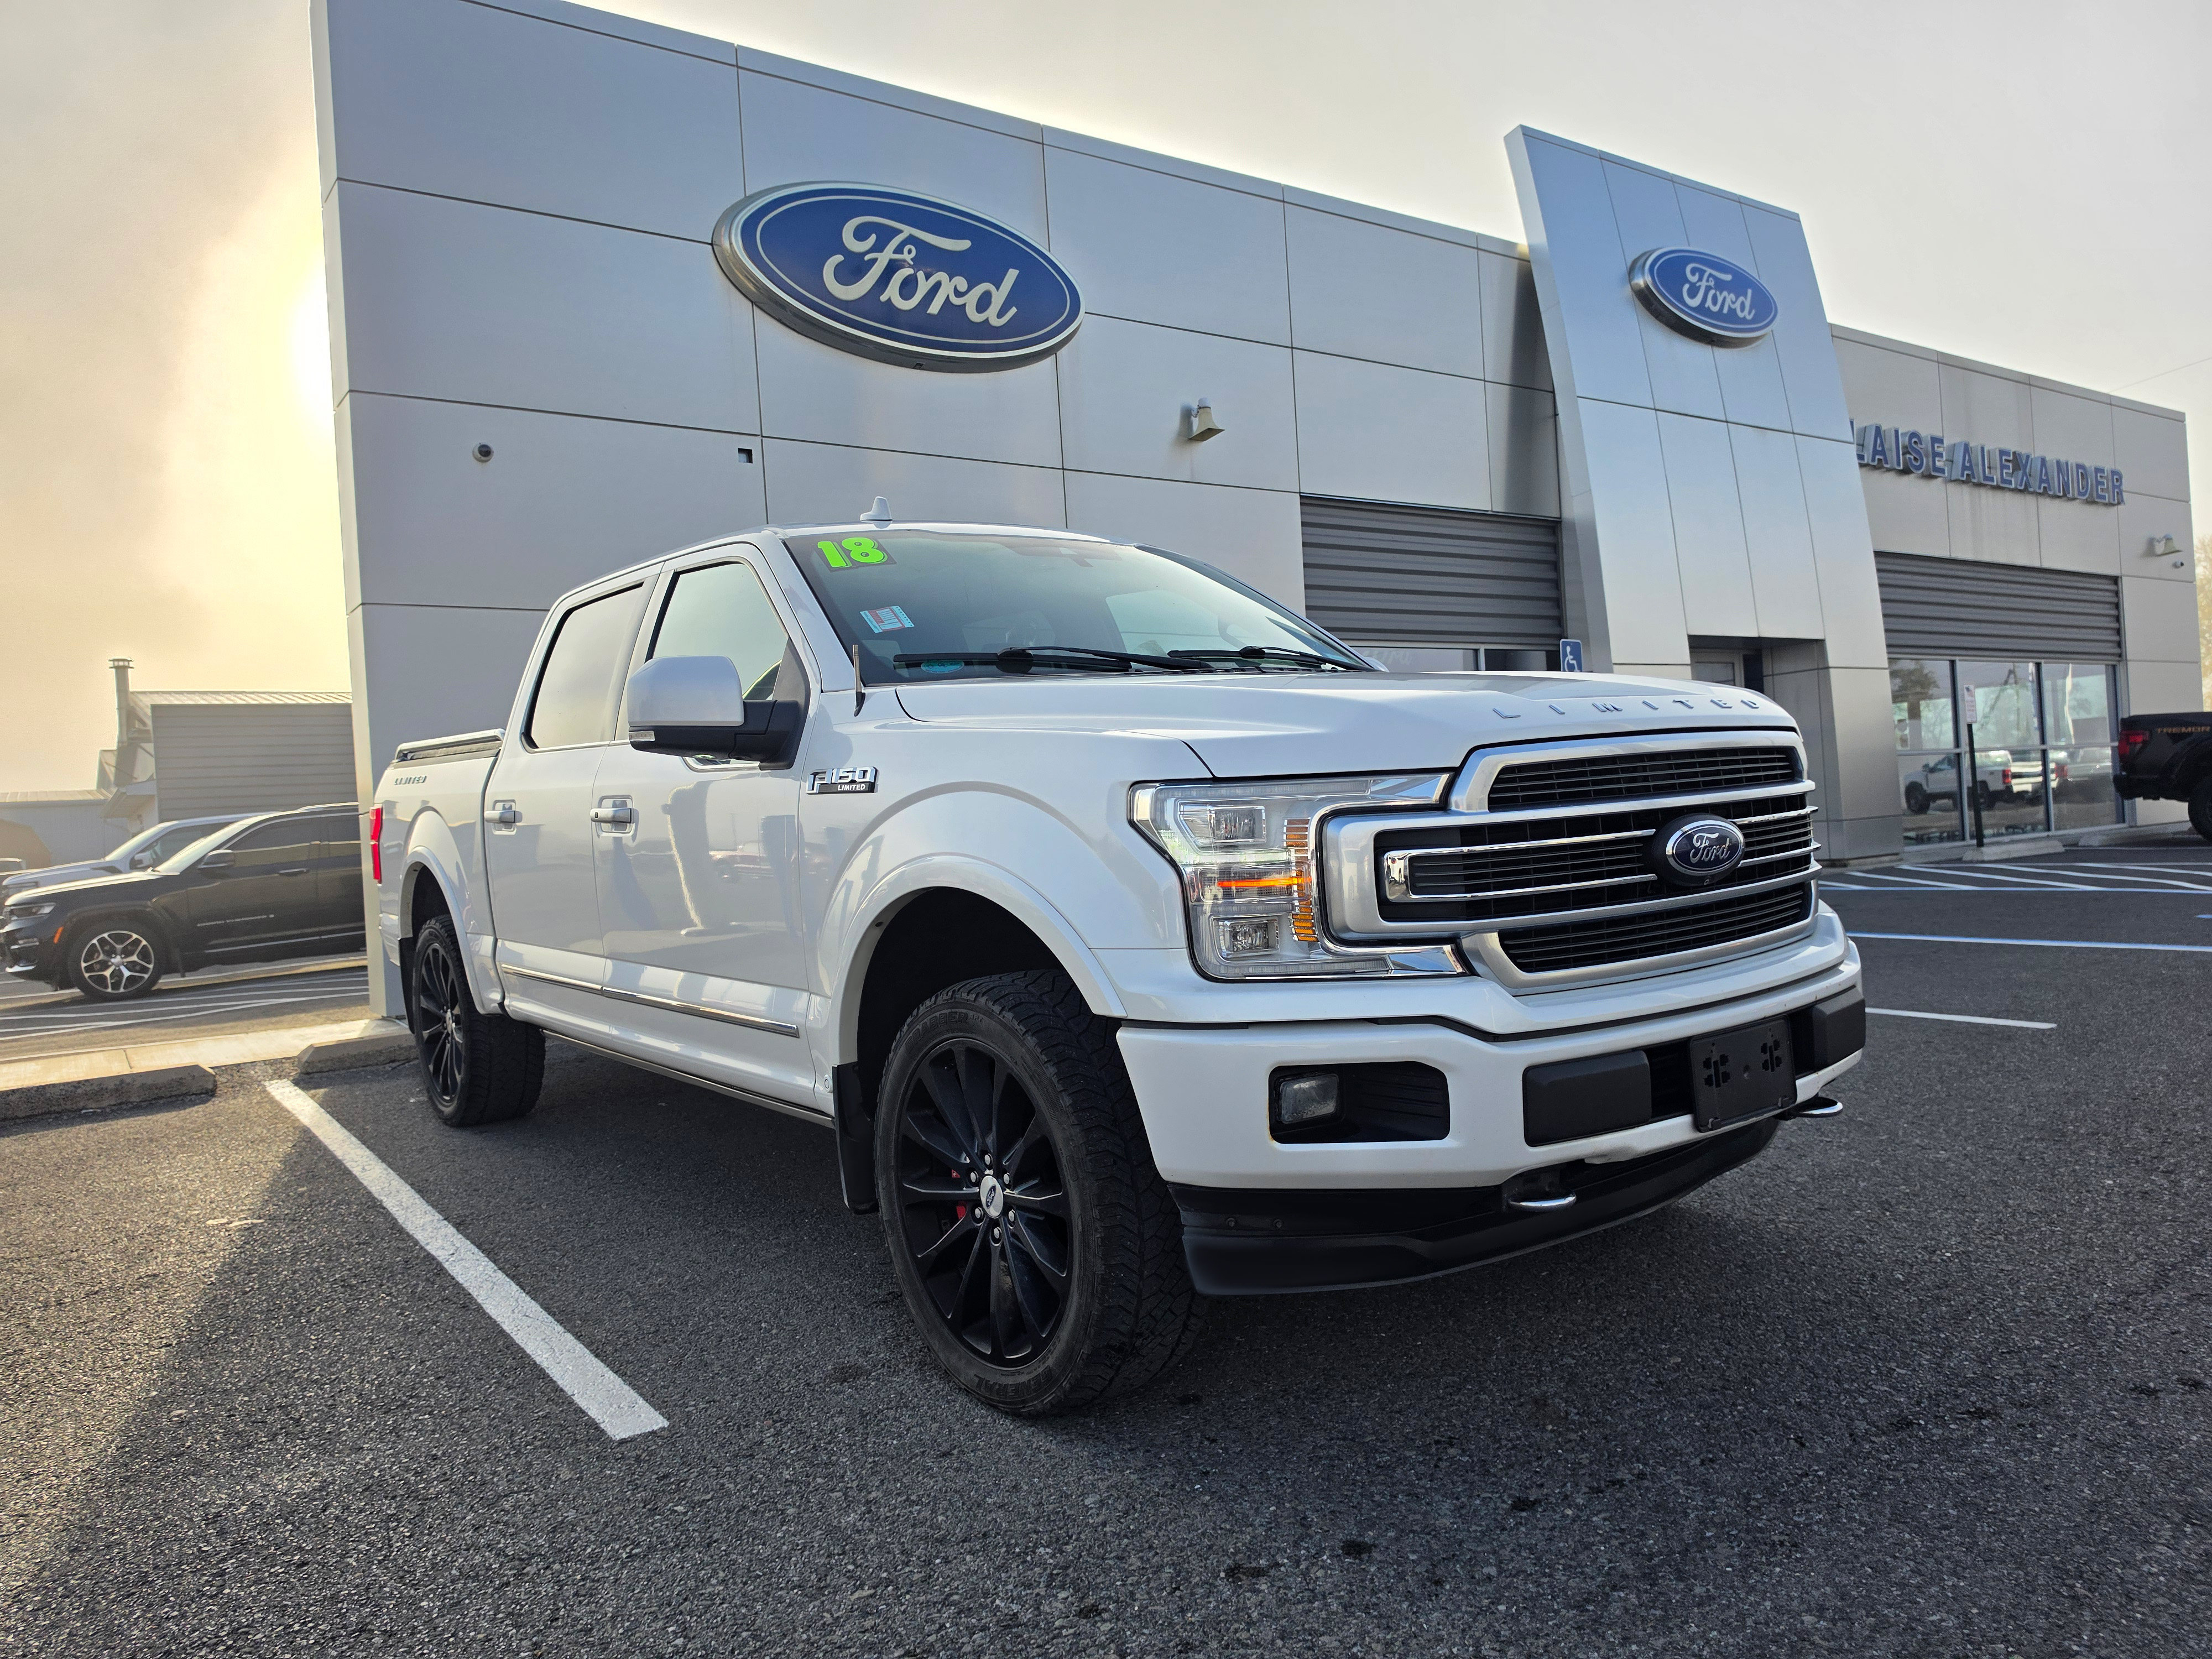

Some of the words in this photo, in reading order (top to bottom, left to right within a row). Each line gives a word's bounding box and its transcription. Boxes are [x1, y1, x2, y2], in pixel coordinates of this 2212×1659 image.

[822, 216, 1020, 327] Ford
[1682, 263, 1755, 320] Ford
[1958, 441, 2125, 505] ALEXANDER
[817, 537, 888, 568] 18
[1493, 699, 1760, 719] LIMITED
[394, 775, 427, 786] LIMITED
[1689, 832, 1730, 864] Ford
